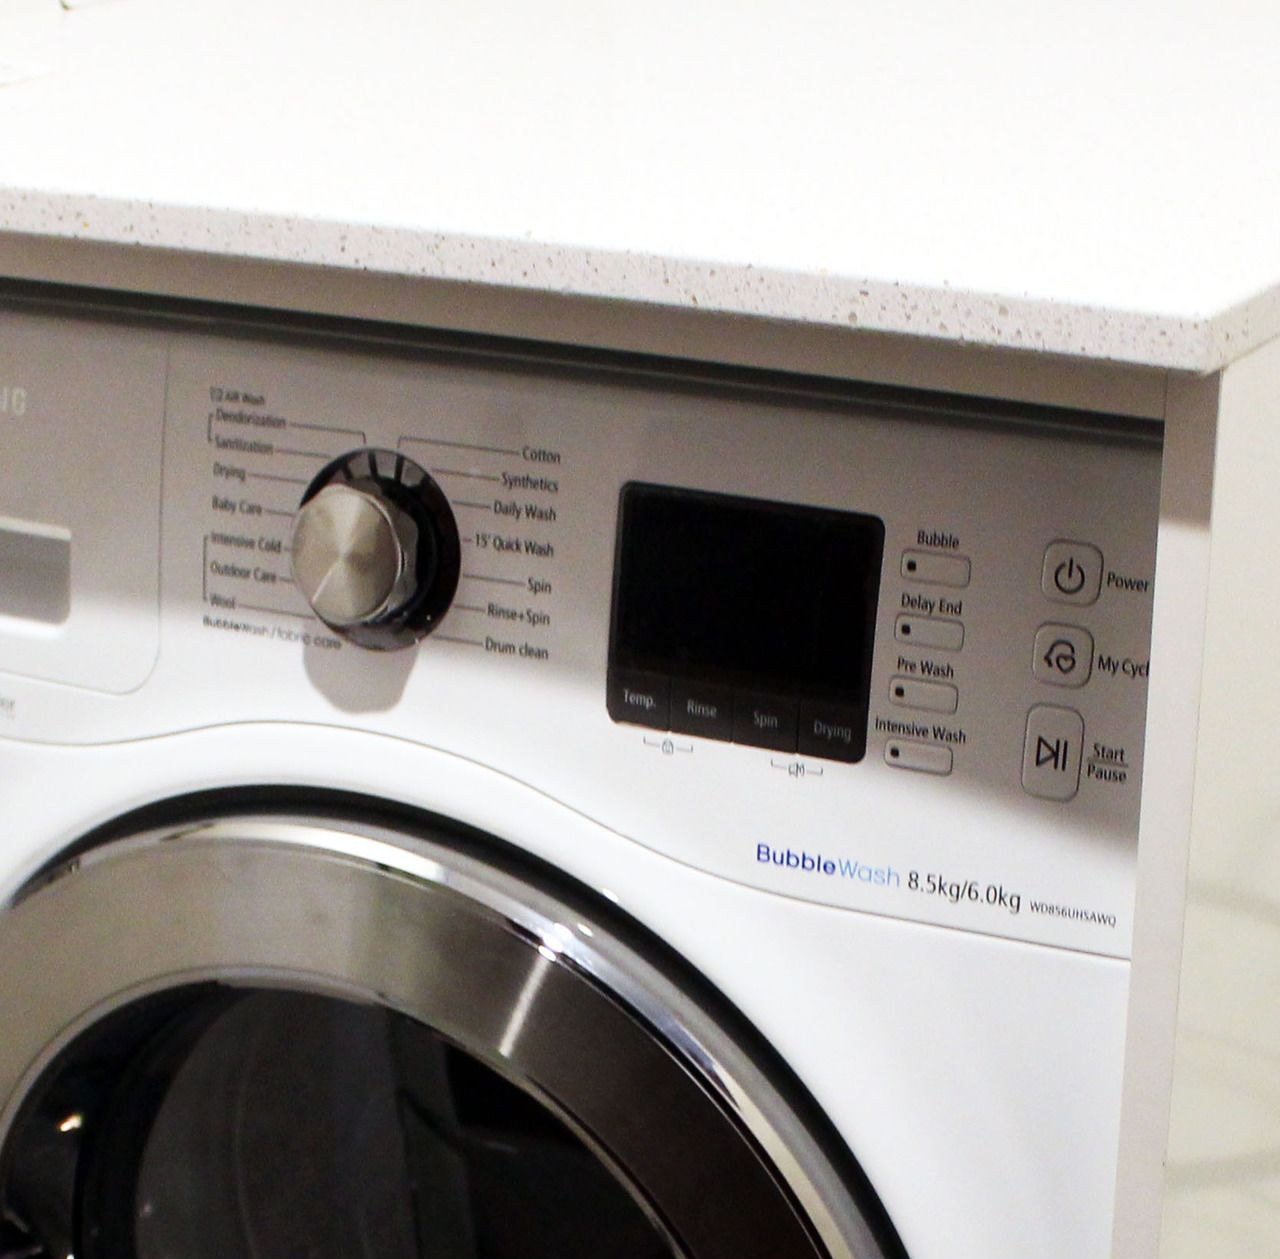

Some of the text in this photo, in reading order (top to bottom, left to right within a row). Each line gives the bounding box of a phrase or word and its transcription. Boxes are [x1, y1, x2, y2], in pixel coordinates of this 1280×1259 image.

[521, 445, 561, 464] Cotton
[213, 461, 246, 482] Drying
[501, 471, 559, 493] Synthetics
[211, 494, 263, 515] Baby Care
[493, 499, 557, 521] Daily Wash
[210, 532, 282, 553] Intensive Cold
[493, 535, 522, 553] Quick
[524, 539, 555, 557] Wash
[917, 529, 960, 549] Bubble
[210, 560, 277, 583] Outdoor Care
[1106, 570, 1150, 593] Power
[526, 576, 552, 595] Spin
[487, 602, 551, 627] Rinse+Spin
[901, 591, 963, 616] Delay End
[485, 636, 549, 660] Drum clean
[897, 655, 955, 680] Pre Wash
[1097, 653, 1151, 678] My Cycl
[623, 687, 658, 709] Temp.
[686, 699, 718, 719] Rinse
[752, 709, 779, 729] Spin
[875, 714, 967, 745] Intensive Wash
[813, 719, 853, 744] Drying
[1093, 742, 1125, 762] Start
[1087, 762, 1128, 783] Pause
[756, 843, 901, 888] BubbleWash
[907, 870, 1022, 915] 8.5kg/6.0kg
